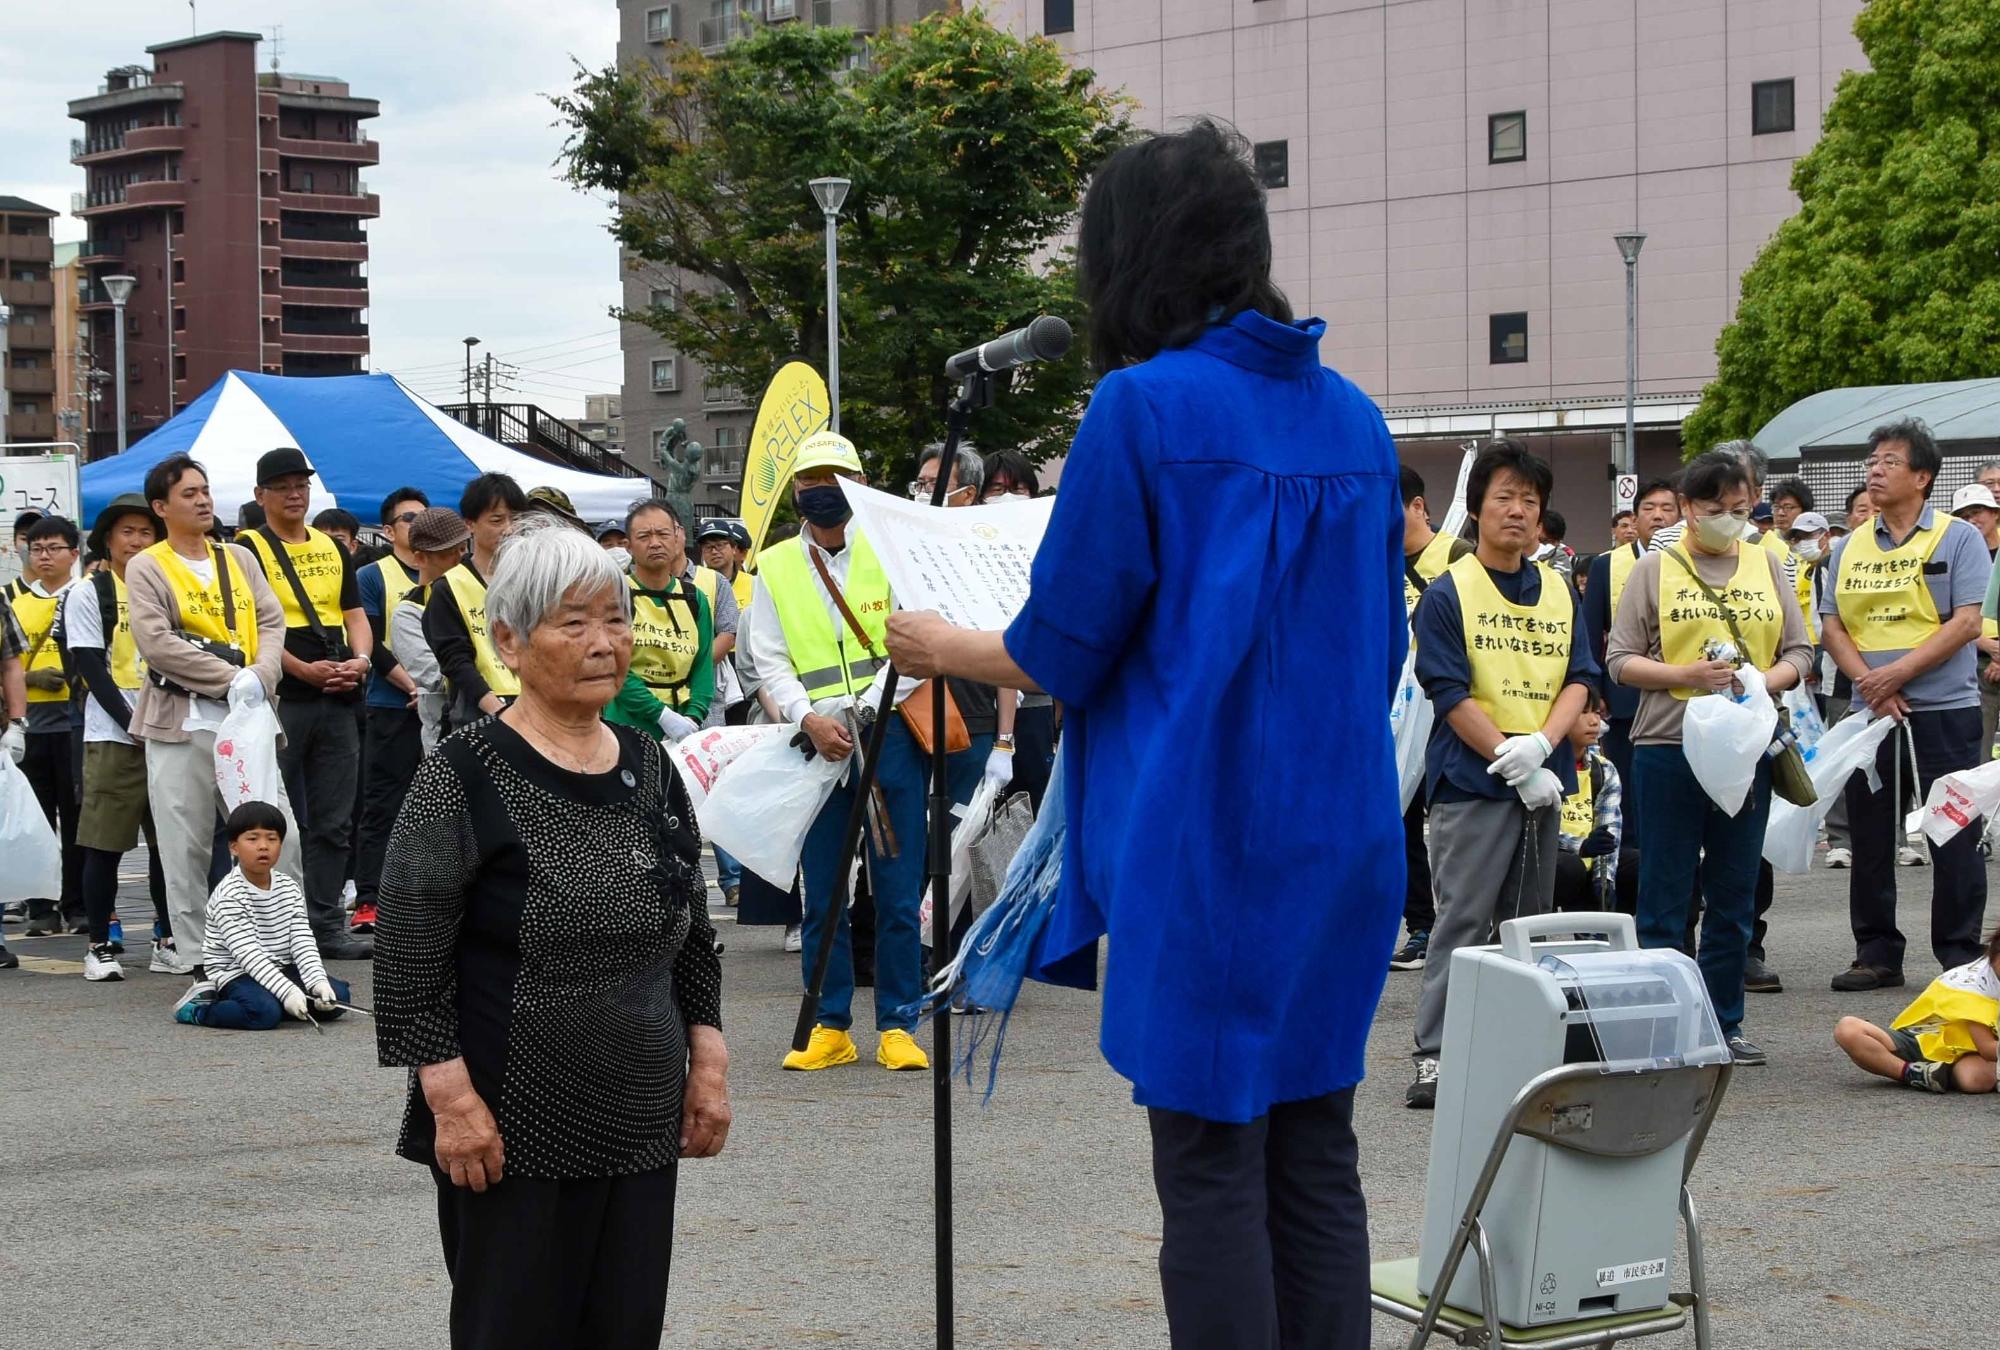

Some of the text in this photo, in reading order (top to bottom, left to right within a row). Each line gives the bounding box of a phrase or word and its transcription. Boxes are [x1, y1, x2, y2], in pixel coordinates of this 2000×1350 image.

[14, 487, 60, 510] コース
[1477, 612, 1567, 634] ポイ捨てをやめて
[1623, 1261, 1664, 1279] 市民安全課
[1535, 1301, 1555, 1311] Ni-Cd
